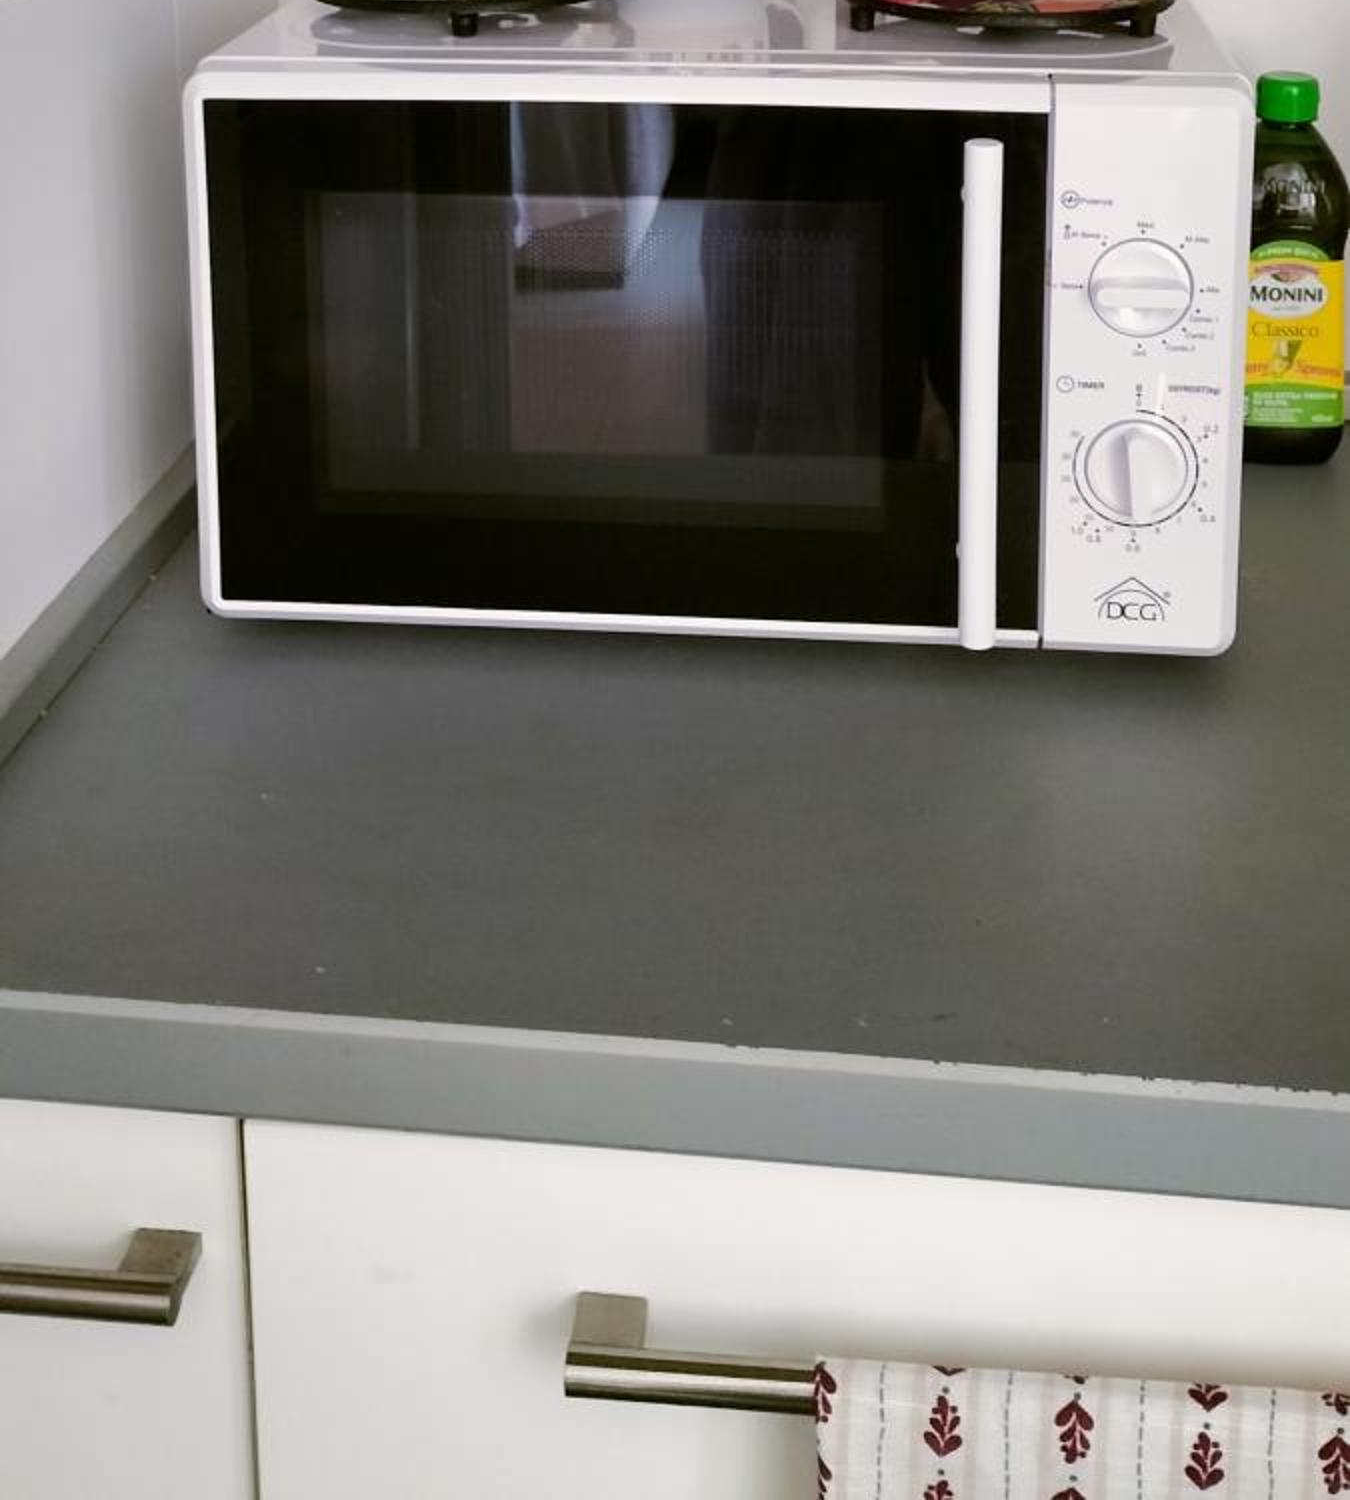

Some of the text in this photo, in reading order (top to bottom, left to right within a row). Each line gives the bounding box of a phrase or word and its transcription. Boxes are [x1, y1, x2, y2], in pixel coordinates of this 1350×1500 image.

[1250, 285, 1324, 303] MONINI
[1252, 321, 1321, 338] Classico
[1106, 601, 1157, 621] DCG
